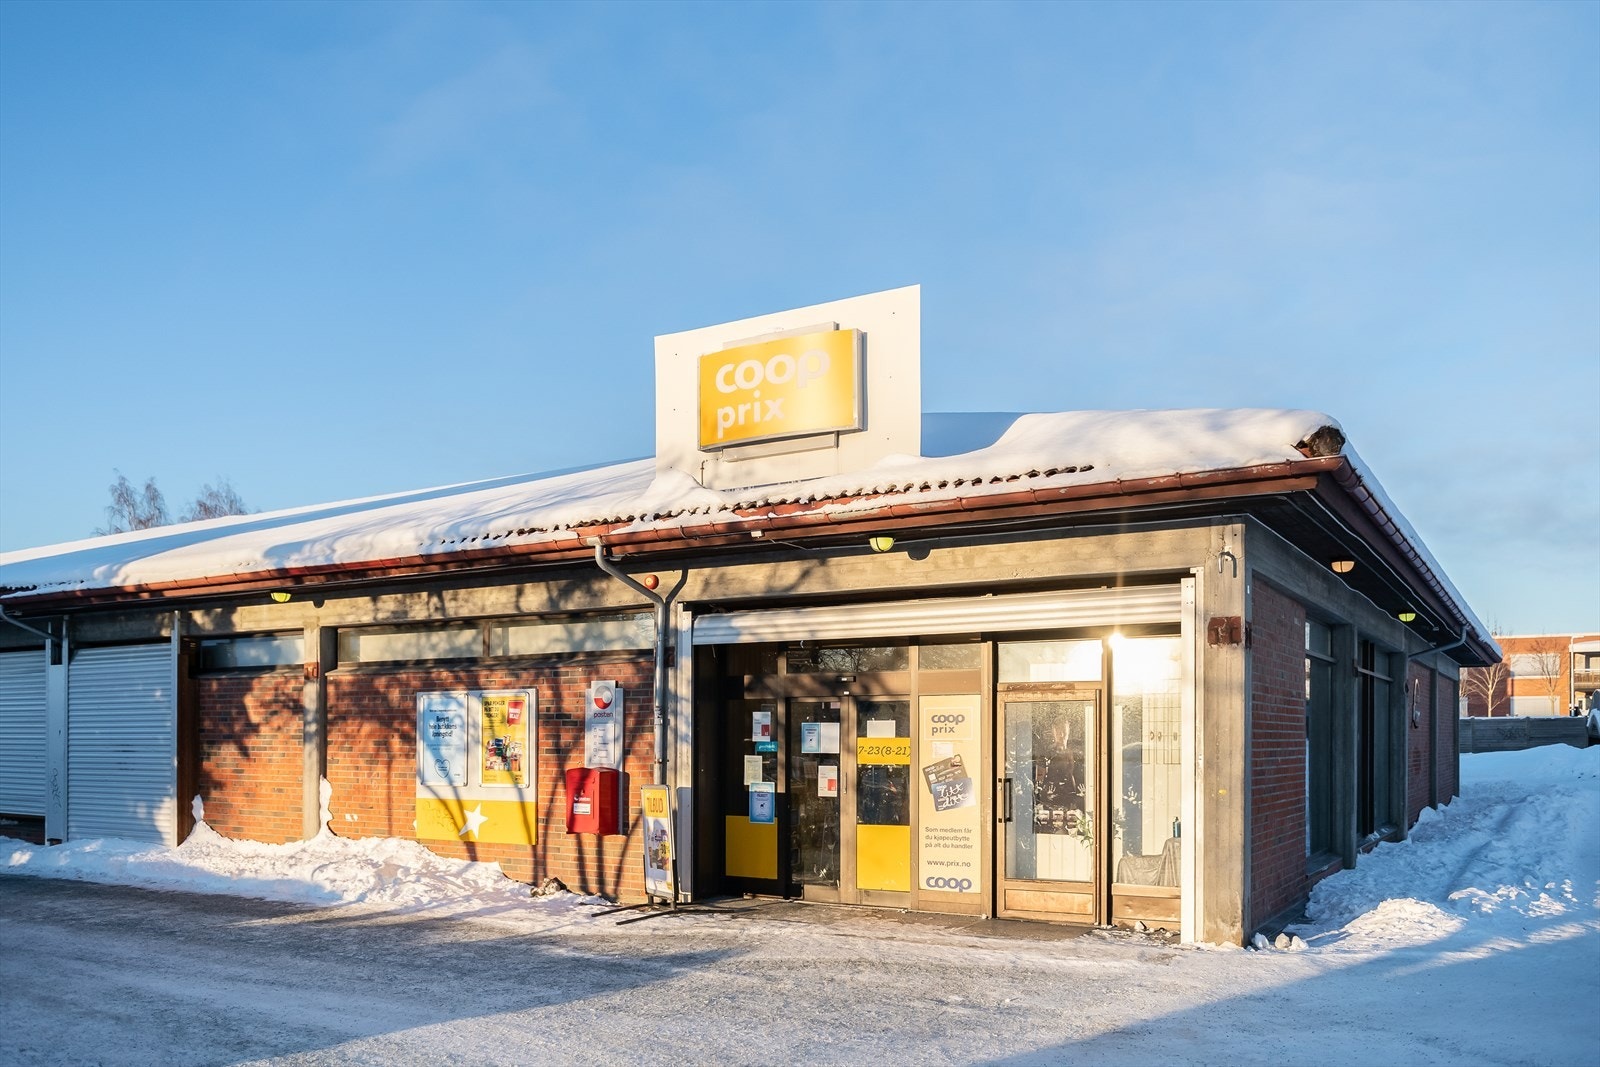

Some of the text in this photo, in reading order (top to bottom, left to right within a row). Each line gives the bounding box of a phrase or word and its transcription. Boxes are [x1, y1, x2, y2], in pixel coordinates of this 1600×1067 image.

[715, 348, 831, 394] coop
[716, 390, 786, 439] prix
[593, 711, 614, 719] posten
[931, 714, 966, 726] coop
[931, 723, 956, 737] prix
[926, 860, 972, 868] www.prix.no
[926, 876, 973, 893] coop
